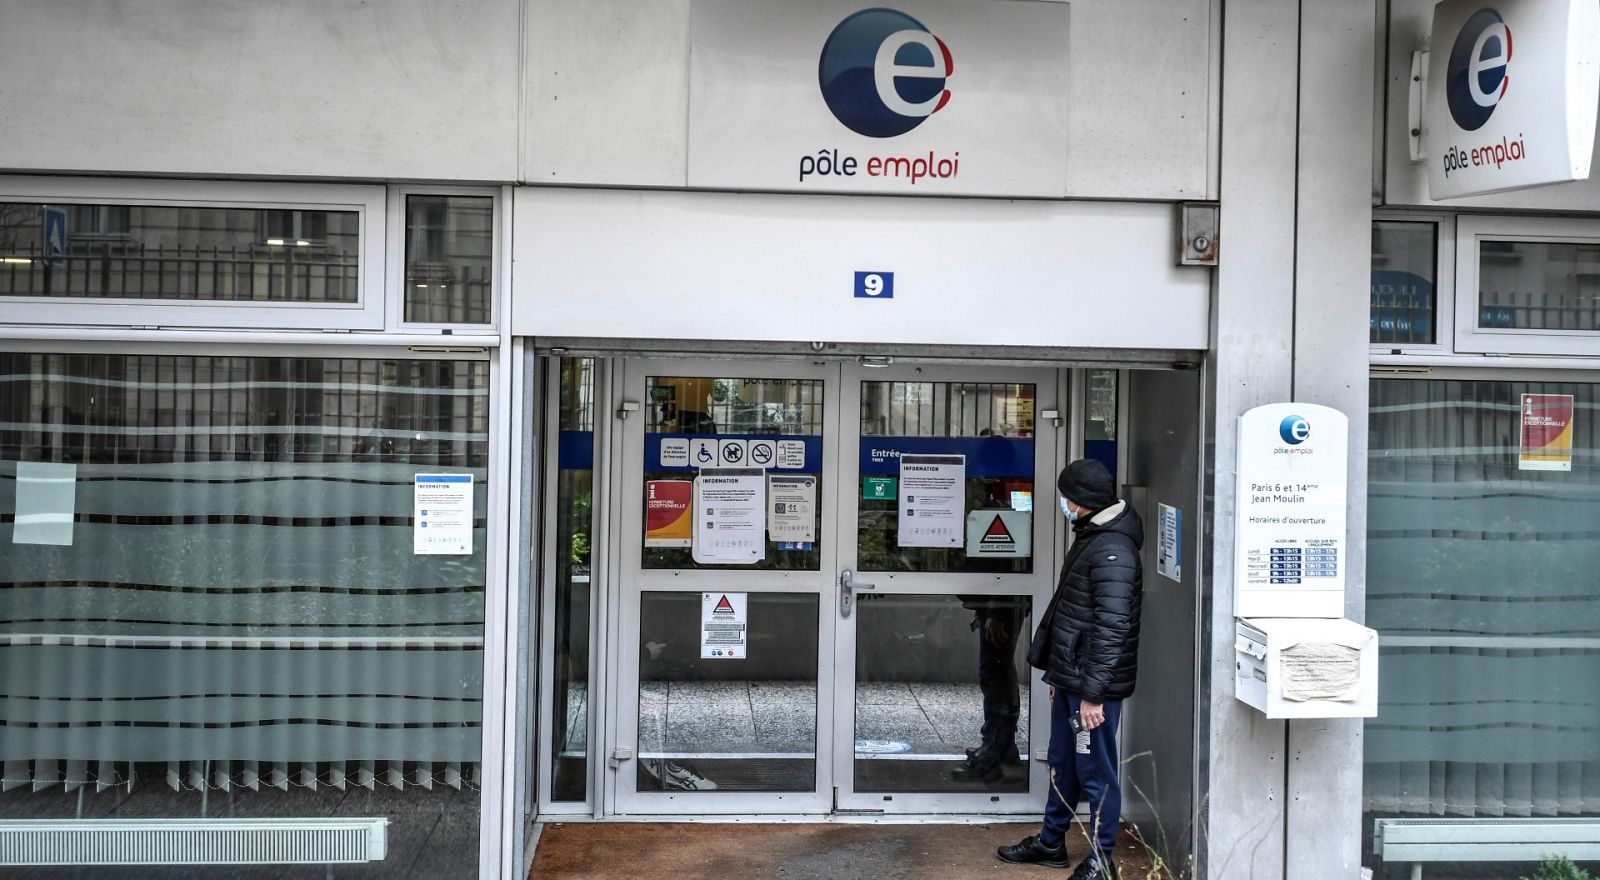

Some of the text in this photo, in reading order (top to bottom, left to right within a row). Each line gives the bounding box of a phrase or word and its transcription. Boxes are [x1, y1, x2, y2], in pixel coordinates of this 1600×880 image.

[1443, 133, 1525, 178] pôle emploi
[799, 148, 959, 185] pôle emploi
[864, 273, 884, 296] 9
[871, 448, 900, 457] Entrée
[1273, 446, 1313, 455] pôle emploi
[1251, 484, 1273, 492] Paris
[1275, 484, 1281, 492] 6
[1283, 484, 1293, 492] et
[1251, 494, 1305, 504] Jean Moulin
[1249, 516, 1326, 525] Horaires d'ouverture
